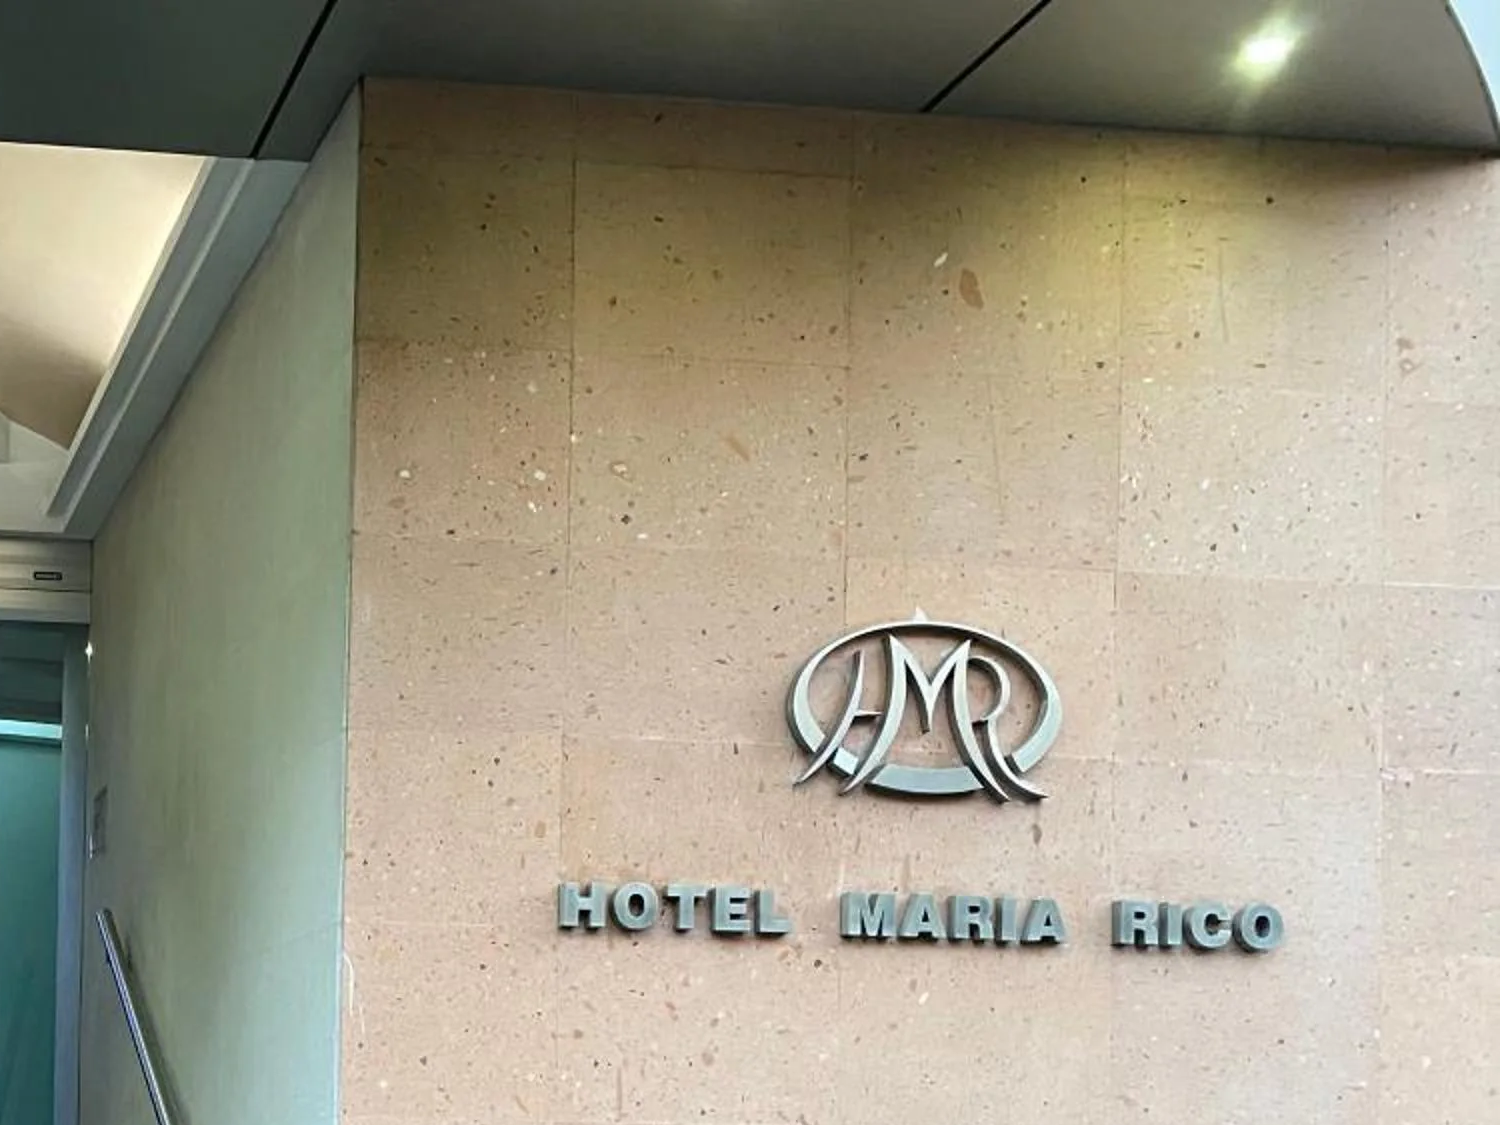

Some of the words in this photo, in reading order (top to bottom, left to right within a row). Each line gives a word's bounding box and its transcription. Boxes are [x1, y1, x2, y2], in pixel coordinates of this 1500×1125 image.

[556, 879, 793, 940] HOTEL
[839, 890, 1067, 947] MARIA
[1110, 897, 1285, 951] RICO
